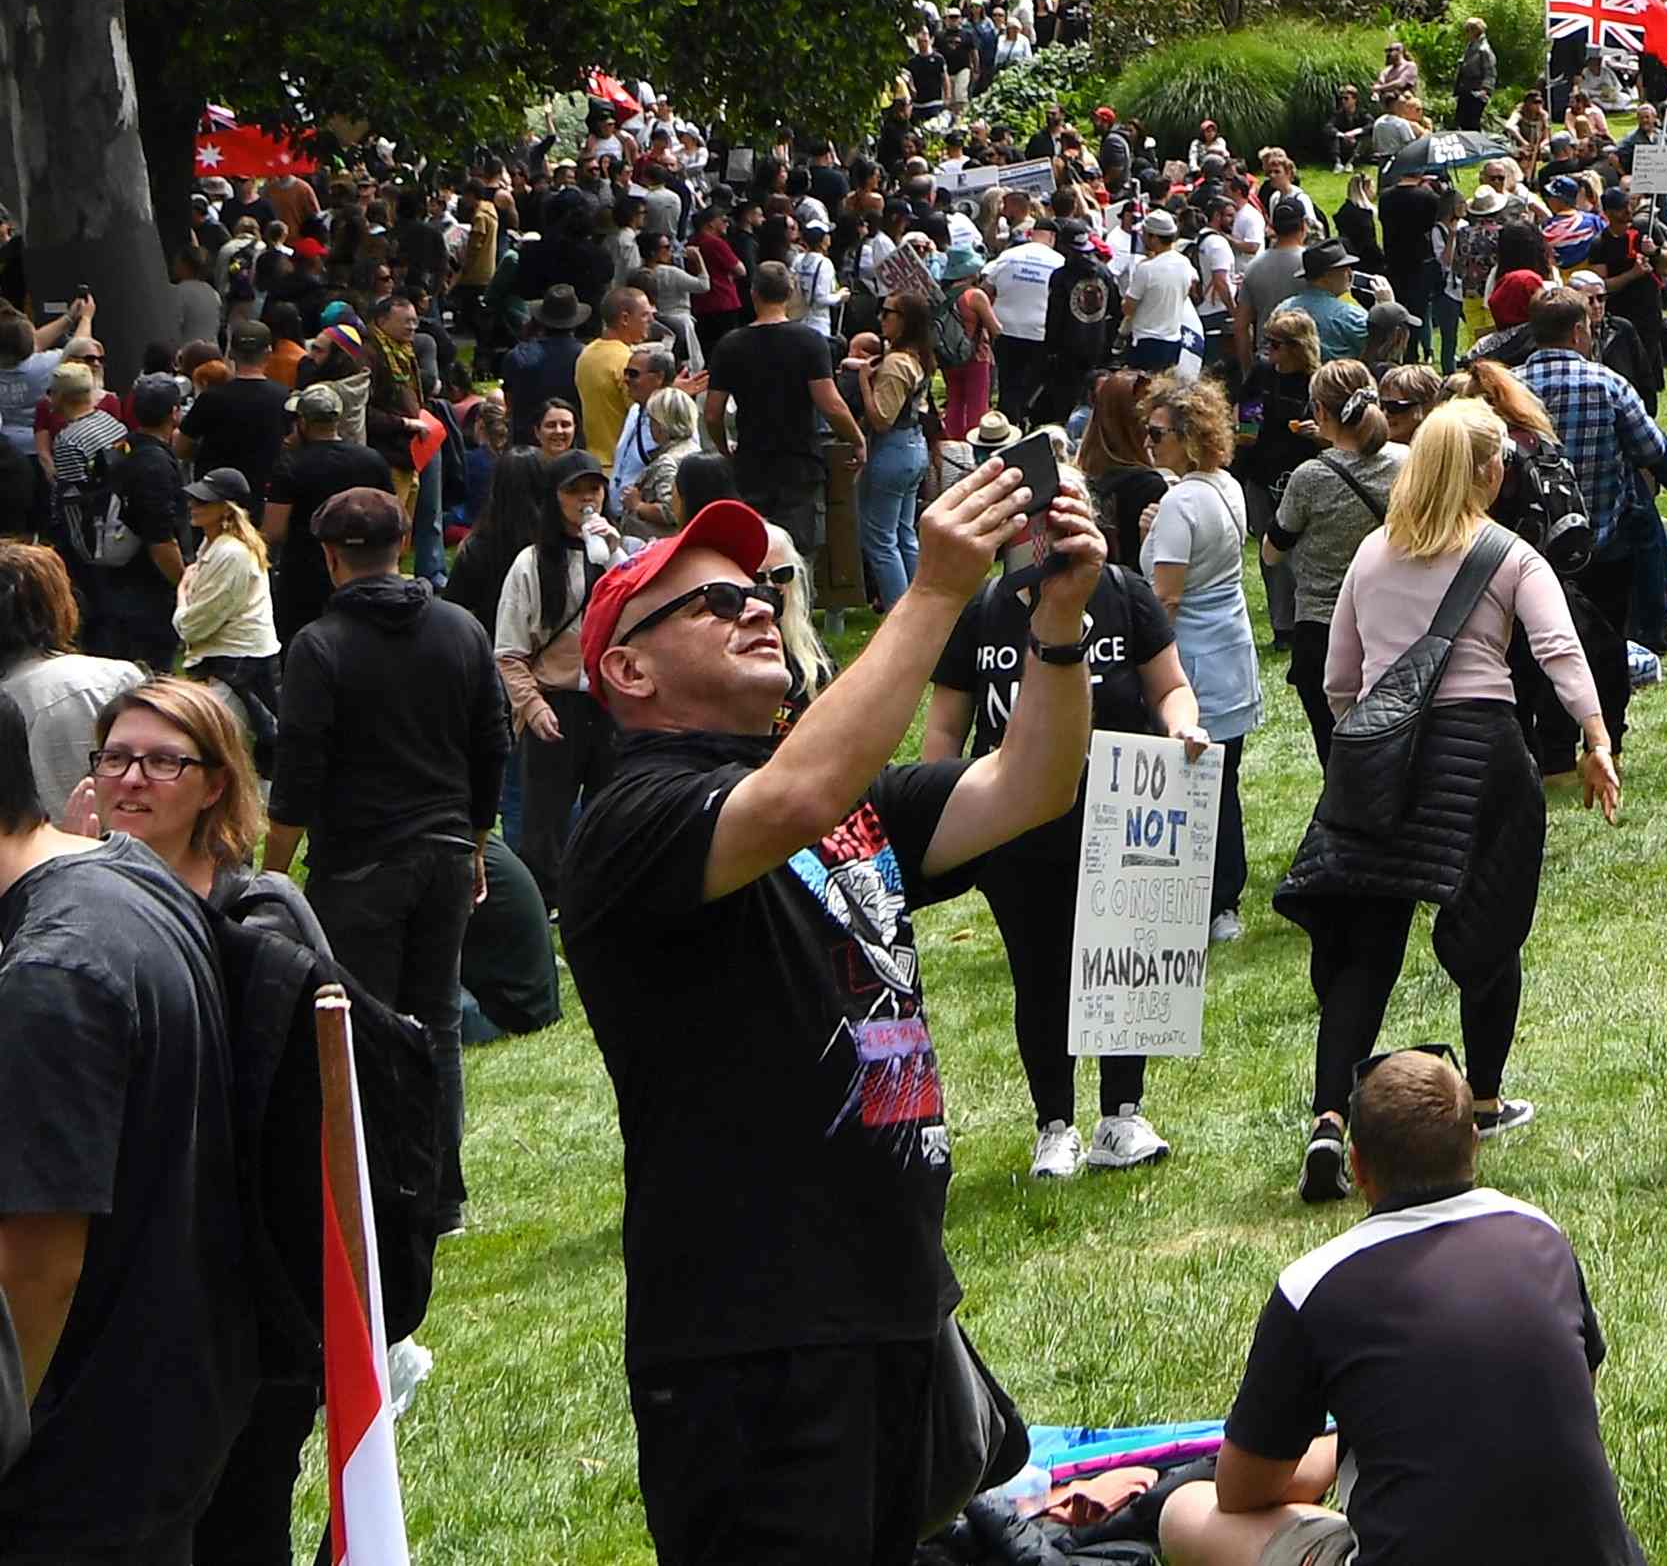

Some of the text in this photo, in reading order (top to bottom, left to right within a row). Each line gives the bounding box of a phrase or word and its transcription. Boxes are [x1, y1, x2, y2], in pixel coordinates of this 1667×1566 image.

[1110, 746, 1122, 793] I
[1134, 747, 1167, 801] DO
[1126, 805, 1187, 857] NOT
[1091, 876, 1211, 926] CONSENT
[1082, 946, 1208, 991] MANDATORY
[1123, 990, 1172, 1025] JABS
